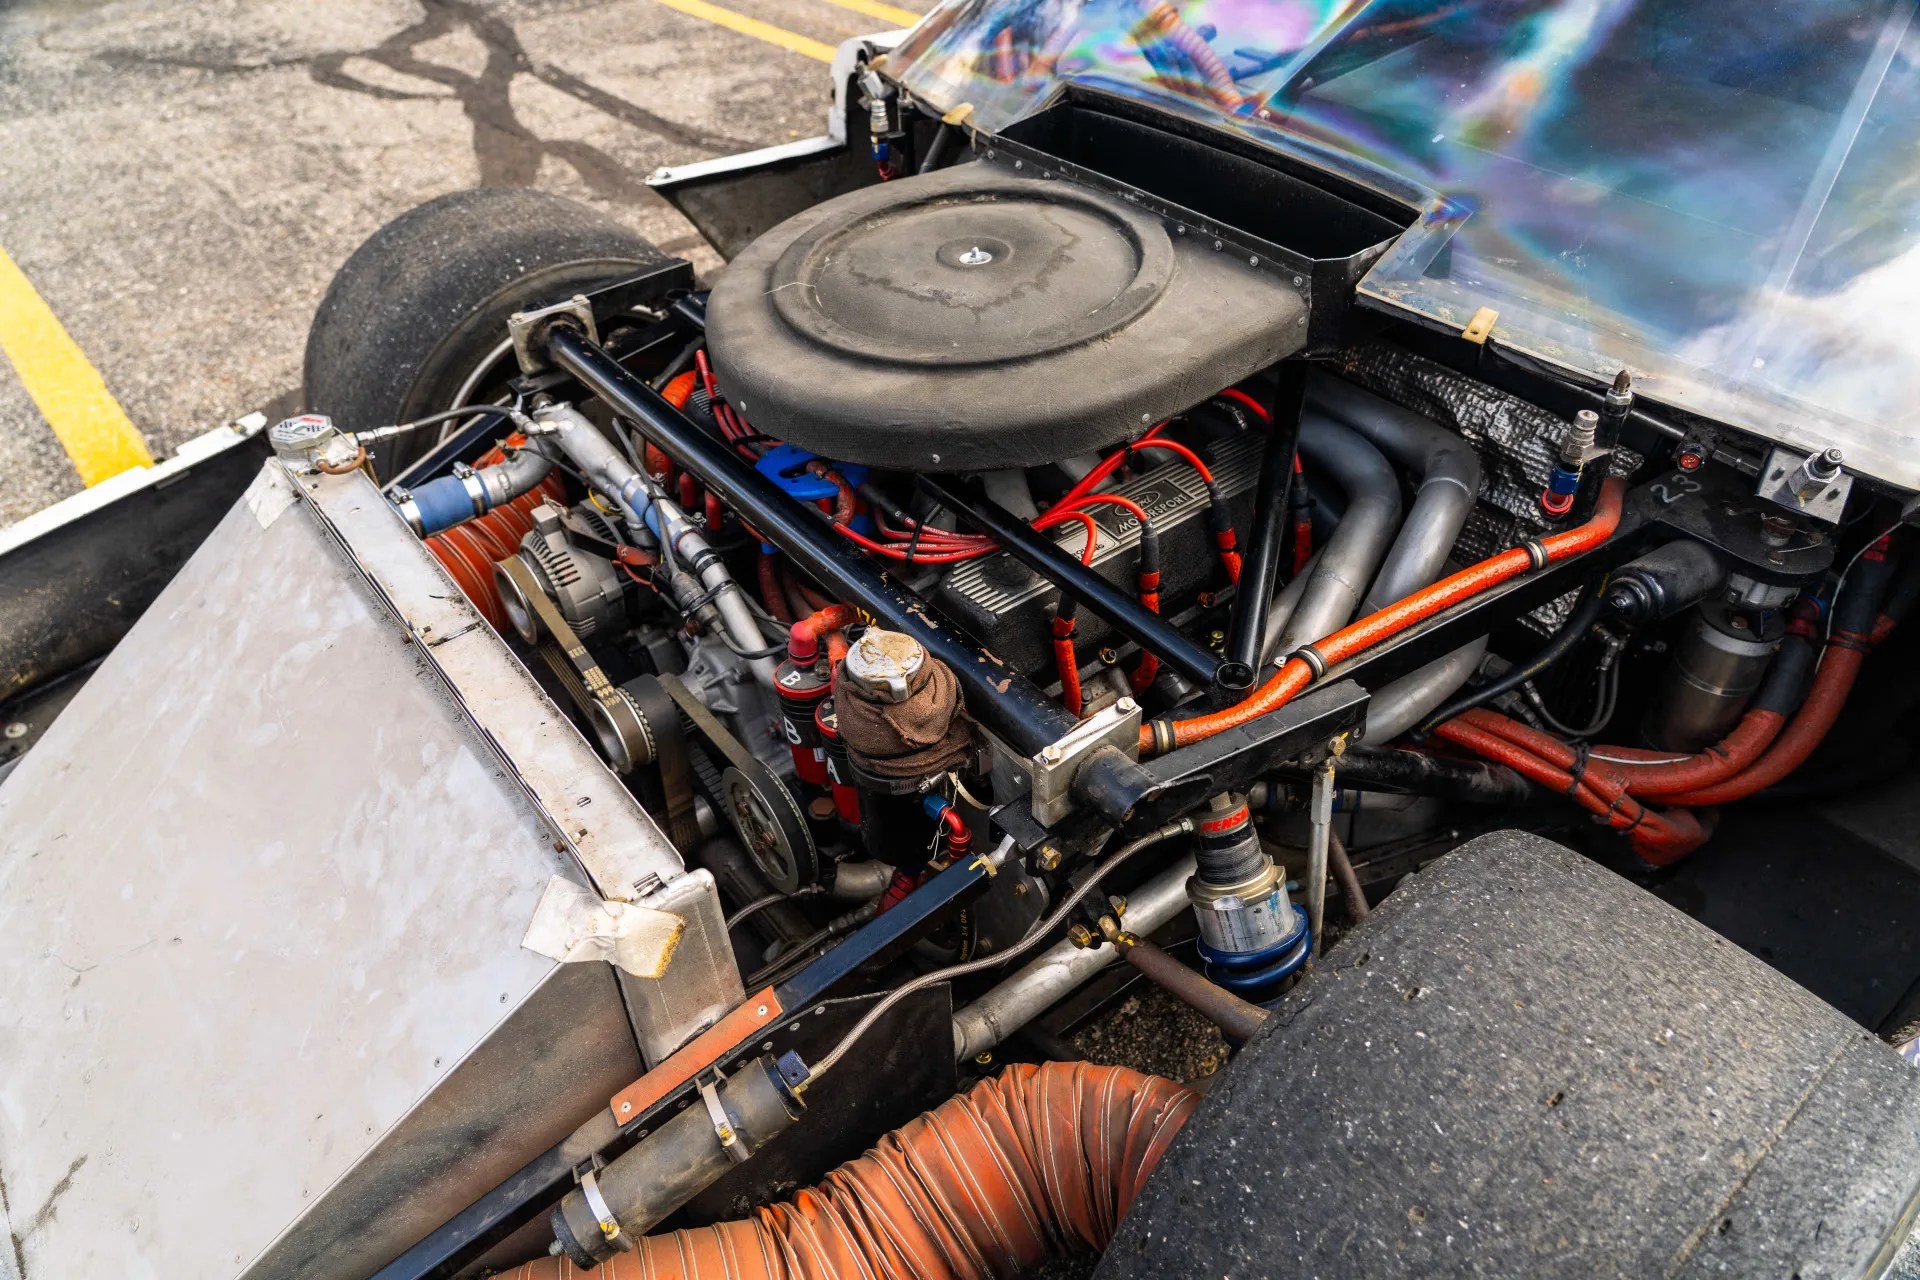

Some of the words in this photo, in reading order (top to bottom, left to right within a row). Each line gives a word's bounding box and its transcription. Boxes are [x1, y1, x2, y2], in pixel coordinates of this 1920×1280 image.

[1650, 474, 1702, 504] 23
[1118, 494, 1189, 534] MOORSPORT
[780, 670, 801, 686] B
[783, 715, 802, 745] B
[827, 756, 842, 785] A
